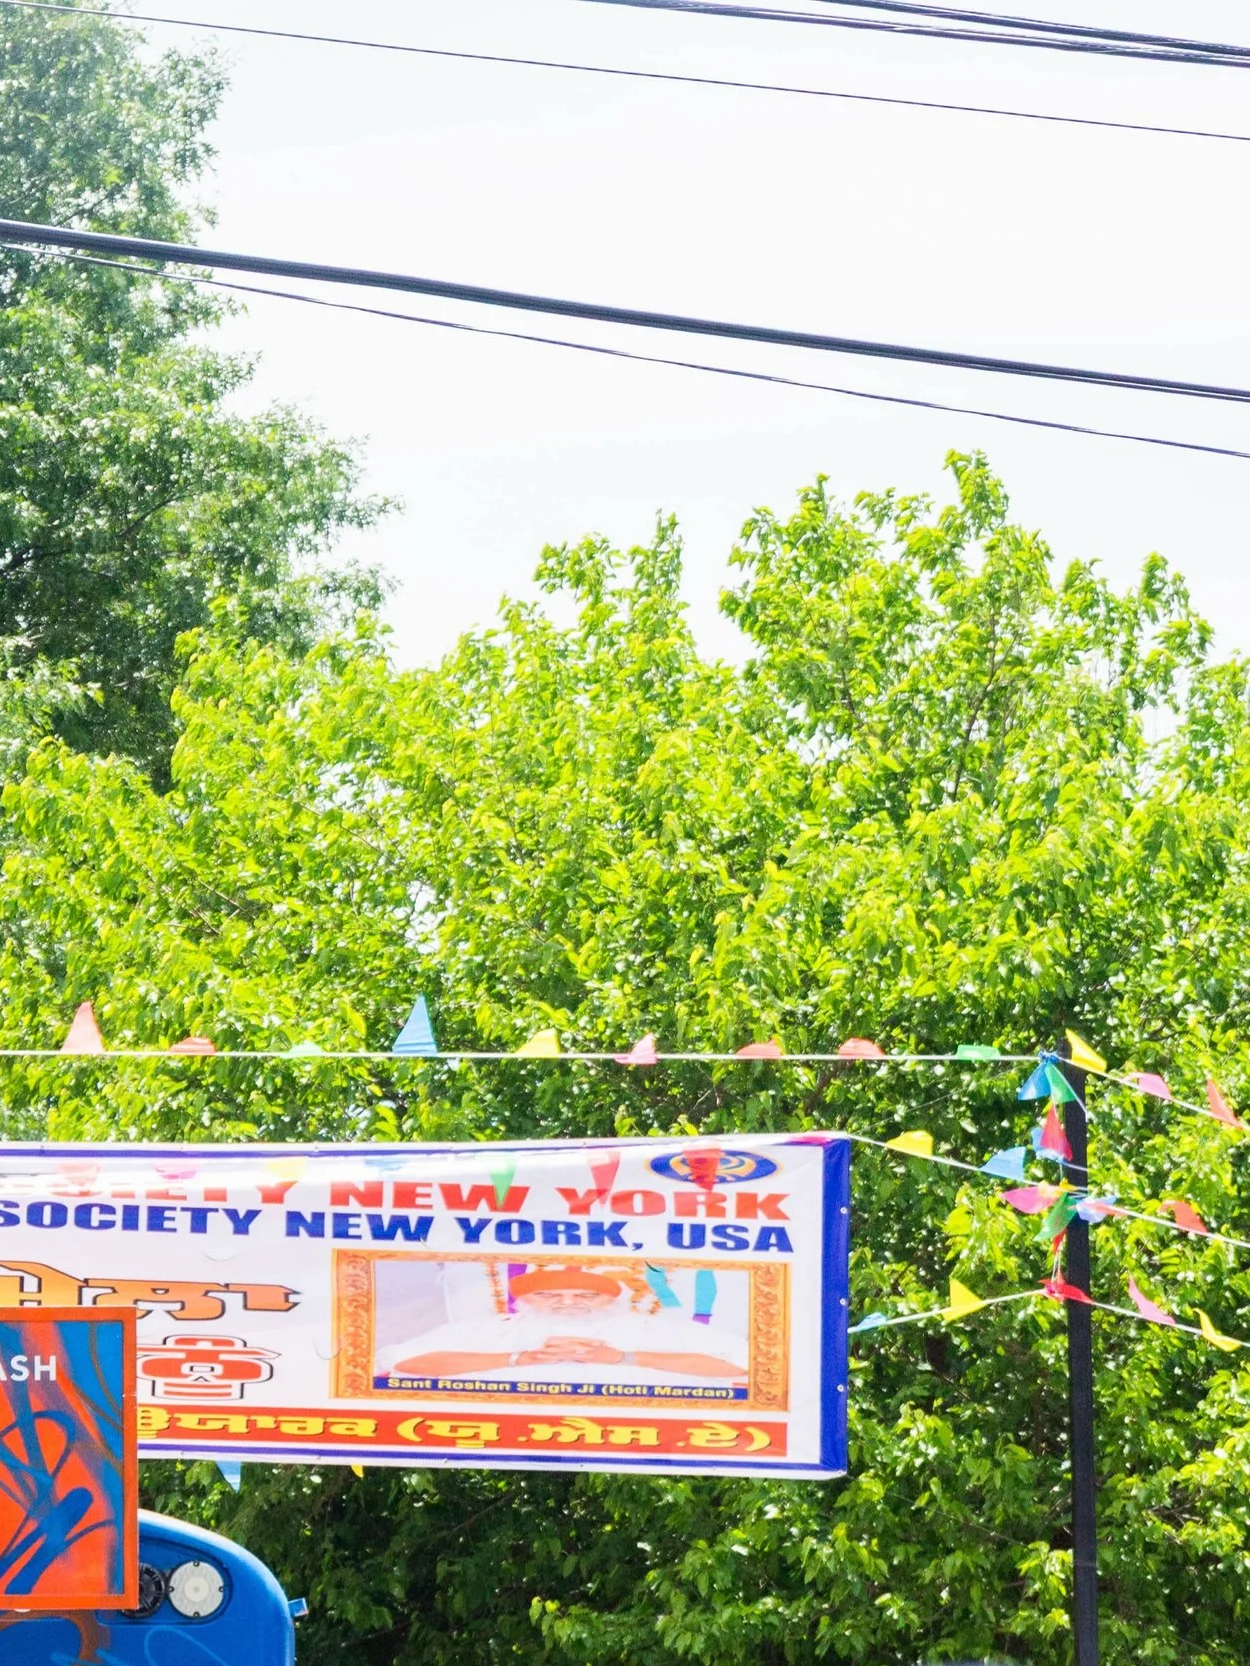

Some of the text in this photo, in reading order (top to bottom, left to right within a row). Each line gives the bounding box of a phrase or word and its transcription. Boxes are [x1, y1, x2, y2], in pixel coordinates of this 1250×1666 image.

[330, 1181, 530, 1213] NEW
[555, 1187, 790, 1221] YORK
[285, 1210, 434, 1243] NEW
[454, 1217, 644, 1250] YORK,
[667, 1223, 794, 1253] USA
[387, 1377, 735, 1399] Sant Roshan Singh Ji (Hoti Mardan)
